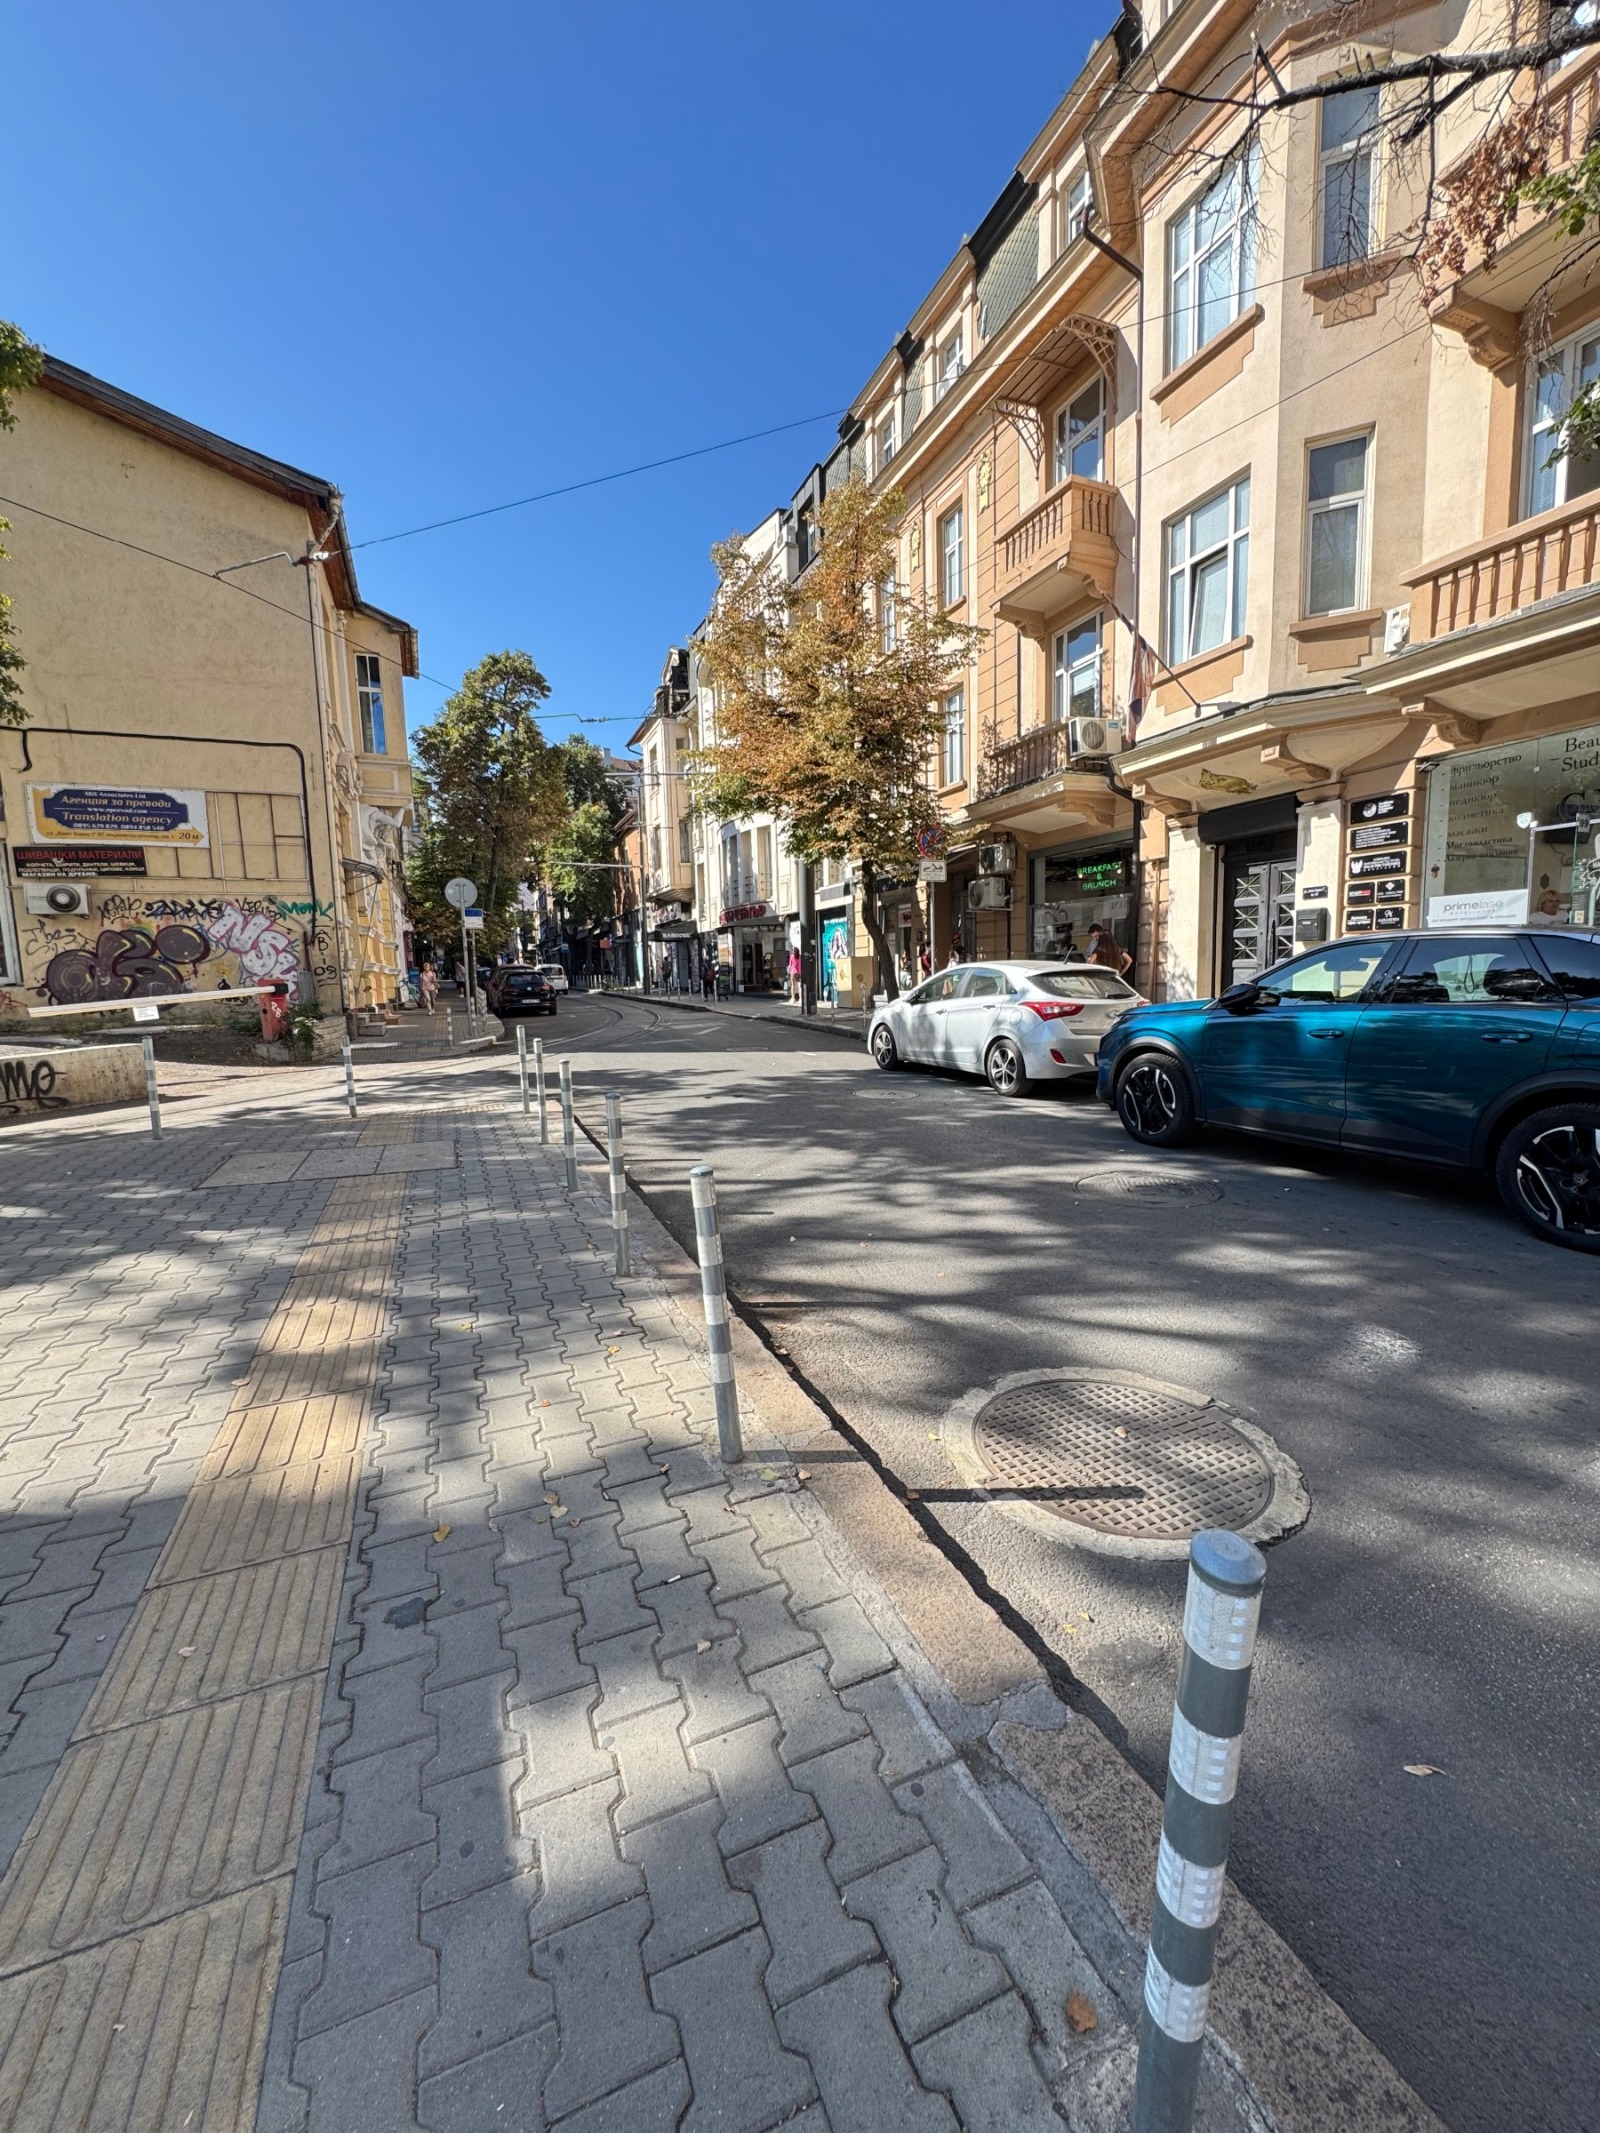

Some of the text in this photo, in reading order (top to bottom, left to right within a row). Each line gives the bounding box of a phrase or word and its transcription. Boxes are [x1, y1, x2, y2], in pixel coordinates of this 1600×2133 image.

[60, 795, 109, 806] Агенция
[126, 799, 172, 808] преводи
[62, 811, 173, 826] Translation agency
[179, 832, 191, 840] 20
[1447, 826, 1488, 838] масажи
[16, 851, 143, 860] ШИВАШКИ МАТЕРИАЛИ
[1077, 861, 1122, 875] BREAKFAST
[1082, 879, 1117, 891] BRUNCH
